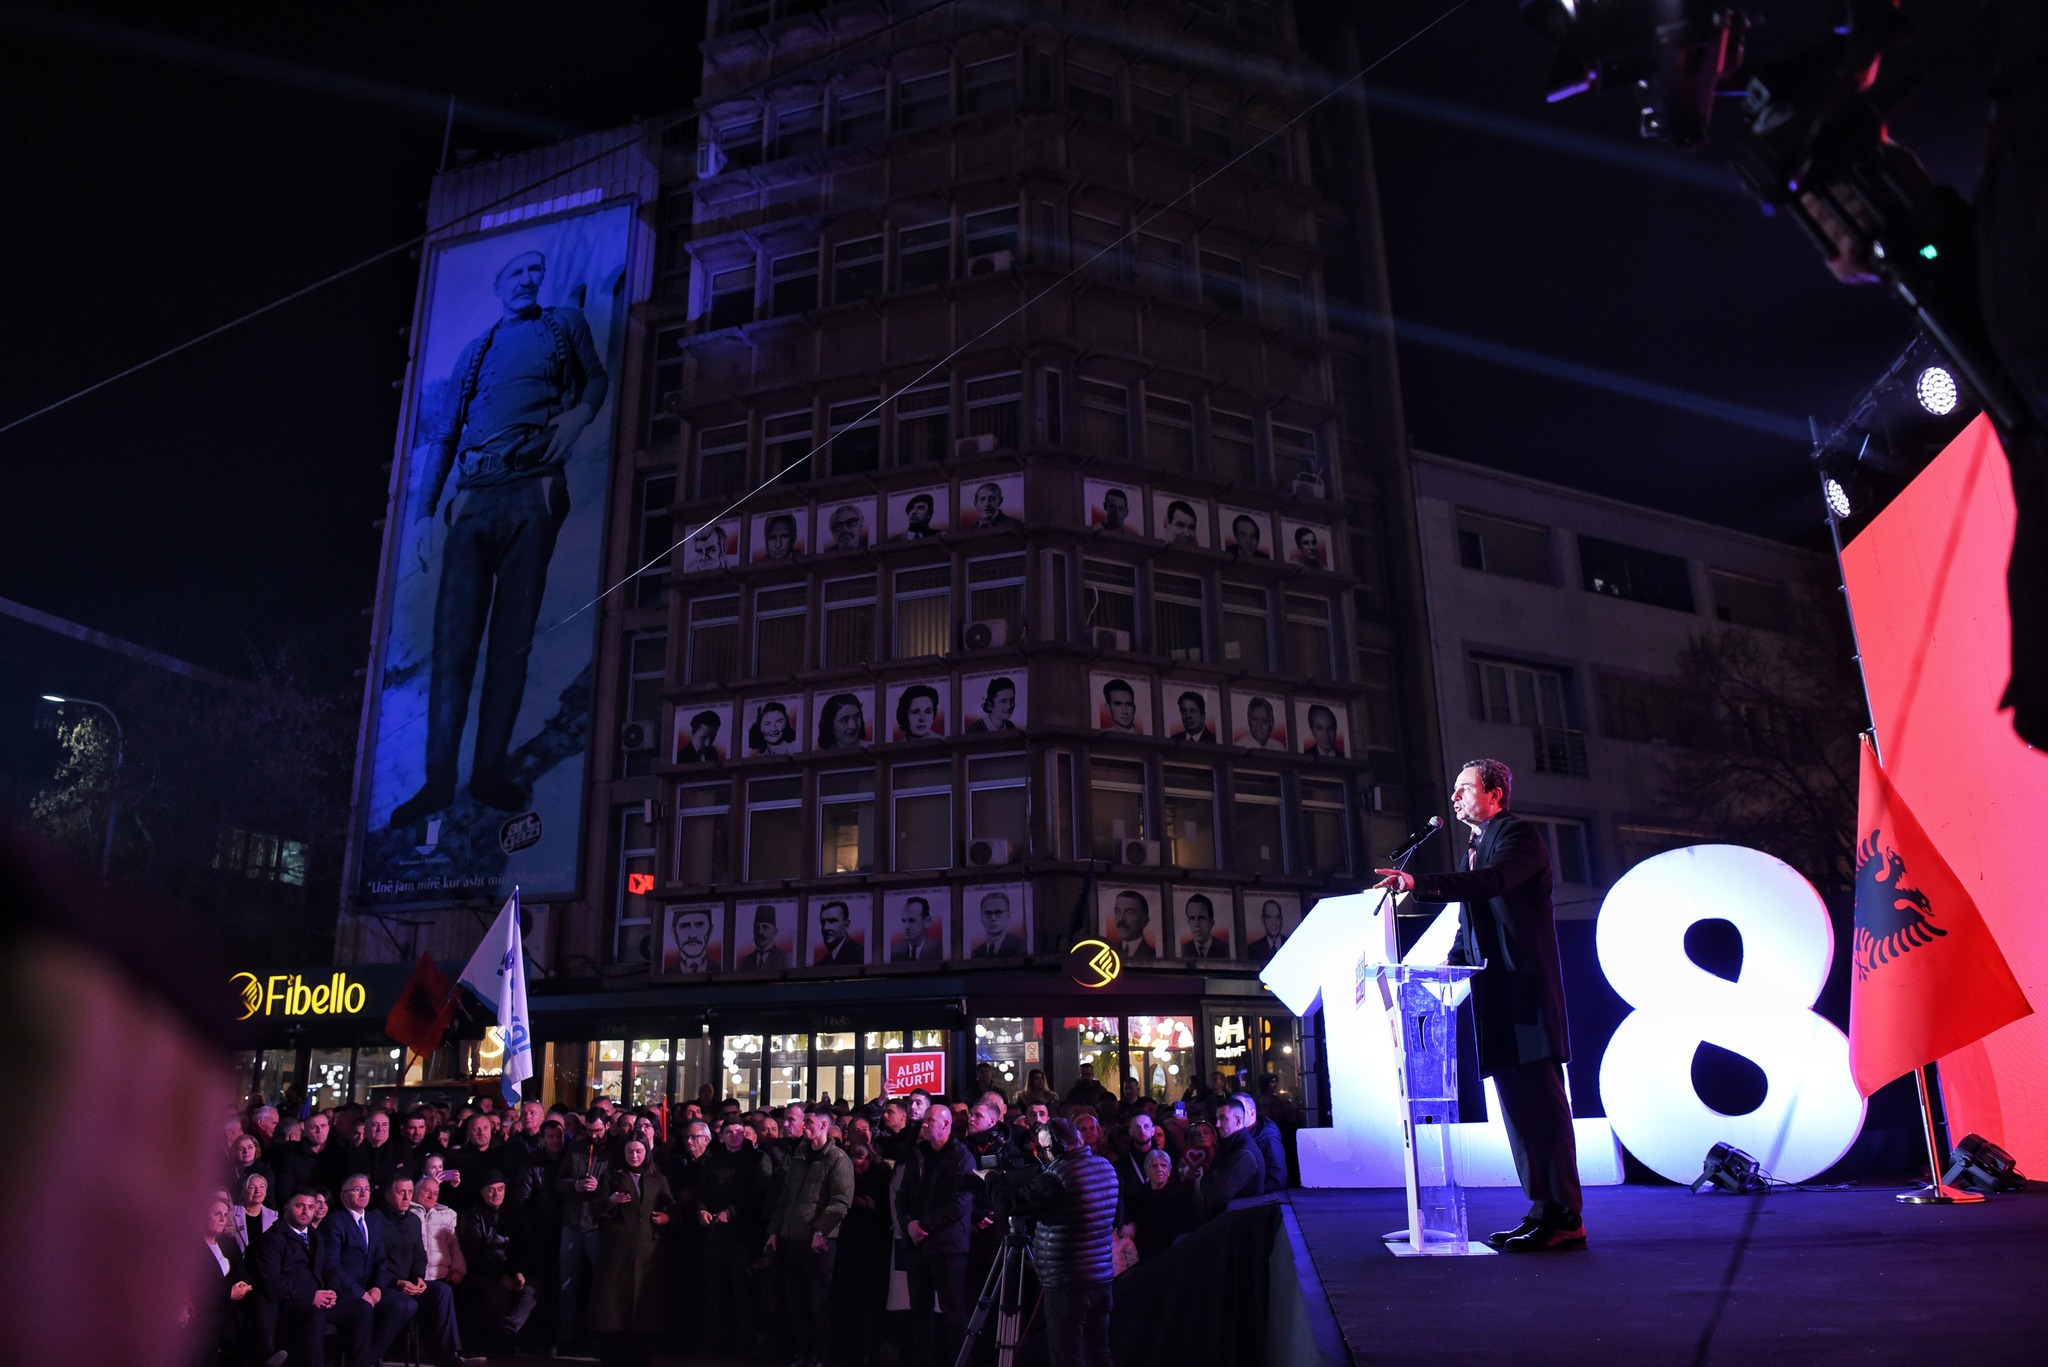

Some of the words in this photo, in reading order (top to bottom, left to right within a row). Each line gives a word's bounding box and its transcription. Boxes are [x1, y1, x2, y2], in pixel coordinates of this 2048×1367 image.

[507, 815, 534, 836] art
[394, 879, 414, 895] jam
[417, 875, 440, 891] mirë
[442, 875, 462, 889] kur
[463, 873, 485, 888] asht
[265, 972, 366, 1016] Fibello
[824, 1015, 852, 1028] Fibello
[897, 1059, 935, 1078] ALBIN
[896, 1071, 935, 1089] KURTI
